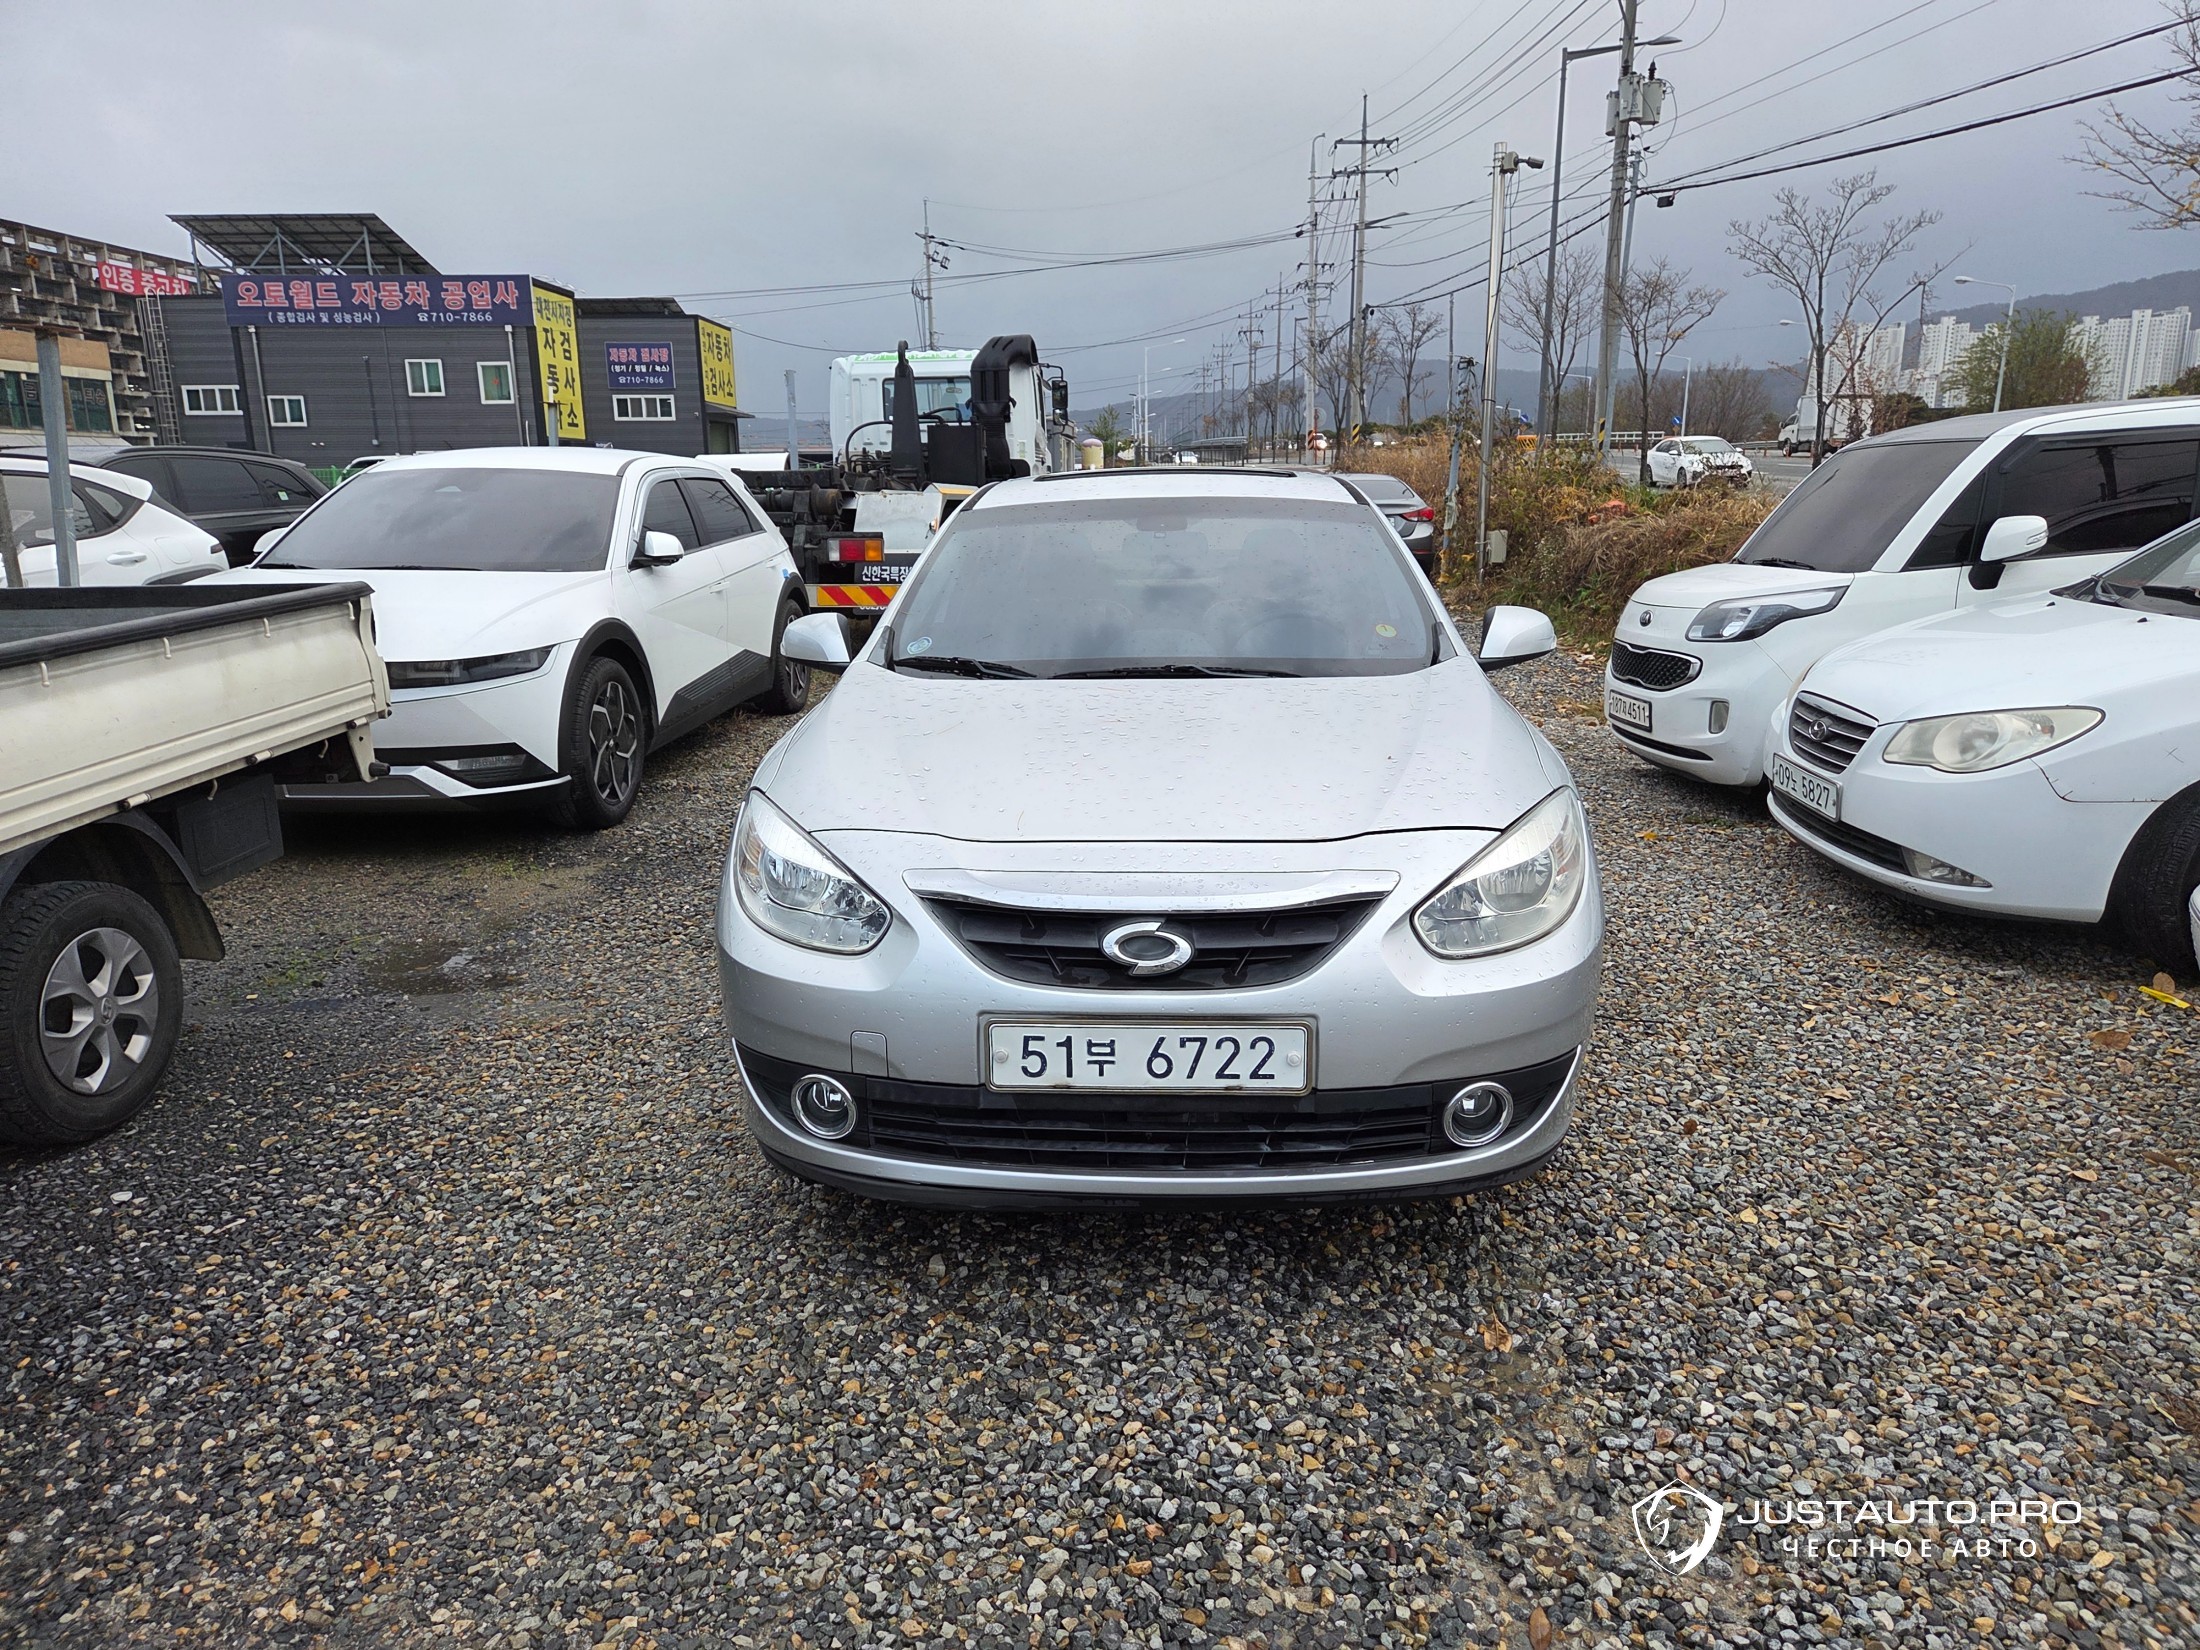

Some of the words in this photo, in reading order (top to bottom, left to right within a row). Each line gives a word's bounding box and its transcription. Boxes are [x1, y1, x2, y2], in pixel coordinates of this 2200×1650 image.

[101, 265, 135, 293] 인증
[140, 273, 187, 295] 중고차
[237, 280, 342, 310] 오토월드
[351, 280, 431, 311] 자동차
[440, 280, 519, 311] 공업사
[320, 312, 330, 323] 및
[536, 296, 572, 328] 대전시지정
[609, 347, 638, 363] 자동차
[706, 331, 731, 365] 자동차
[709, 367, 734, 398] 검사소
[862, 565, 913, 582] 신한국특장
[1778, 763, 1798, 793] 09노
[1801, 775, 1830, 810] 5827
[1021, 1035, 1116, 1079] 51부
[1147, 1036, 1276, 1080] 6722
